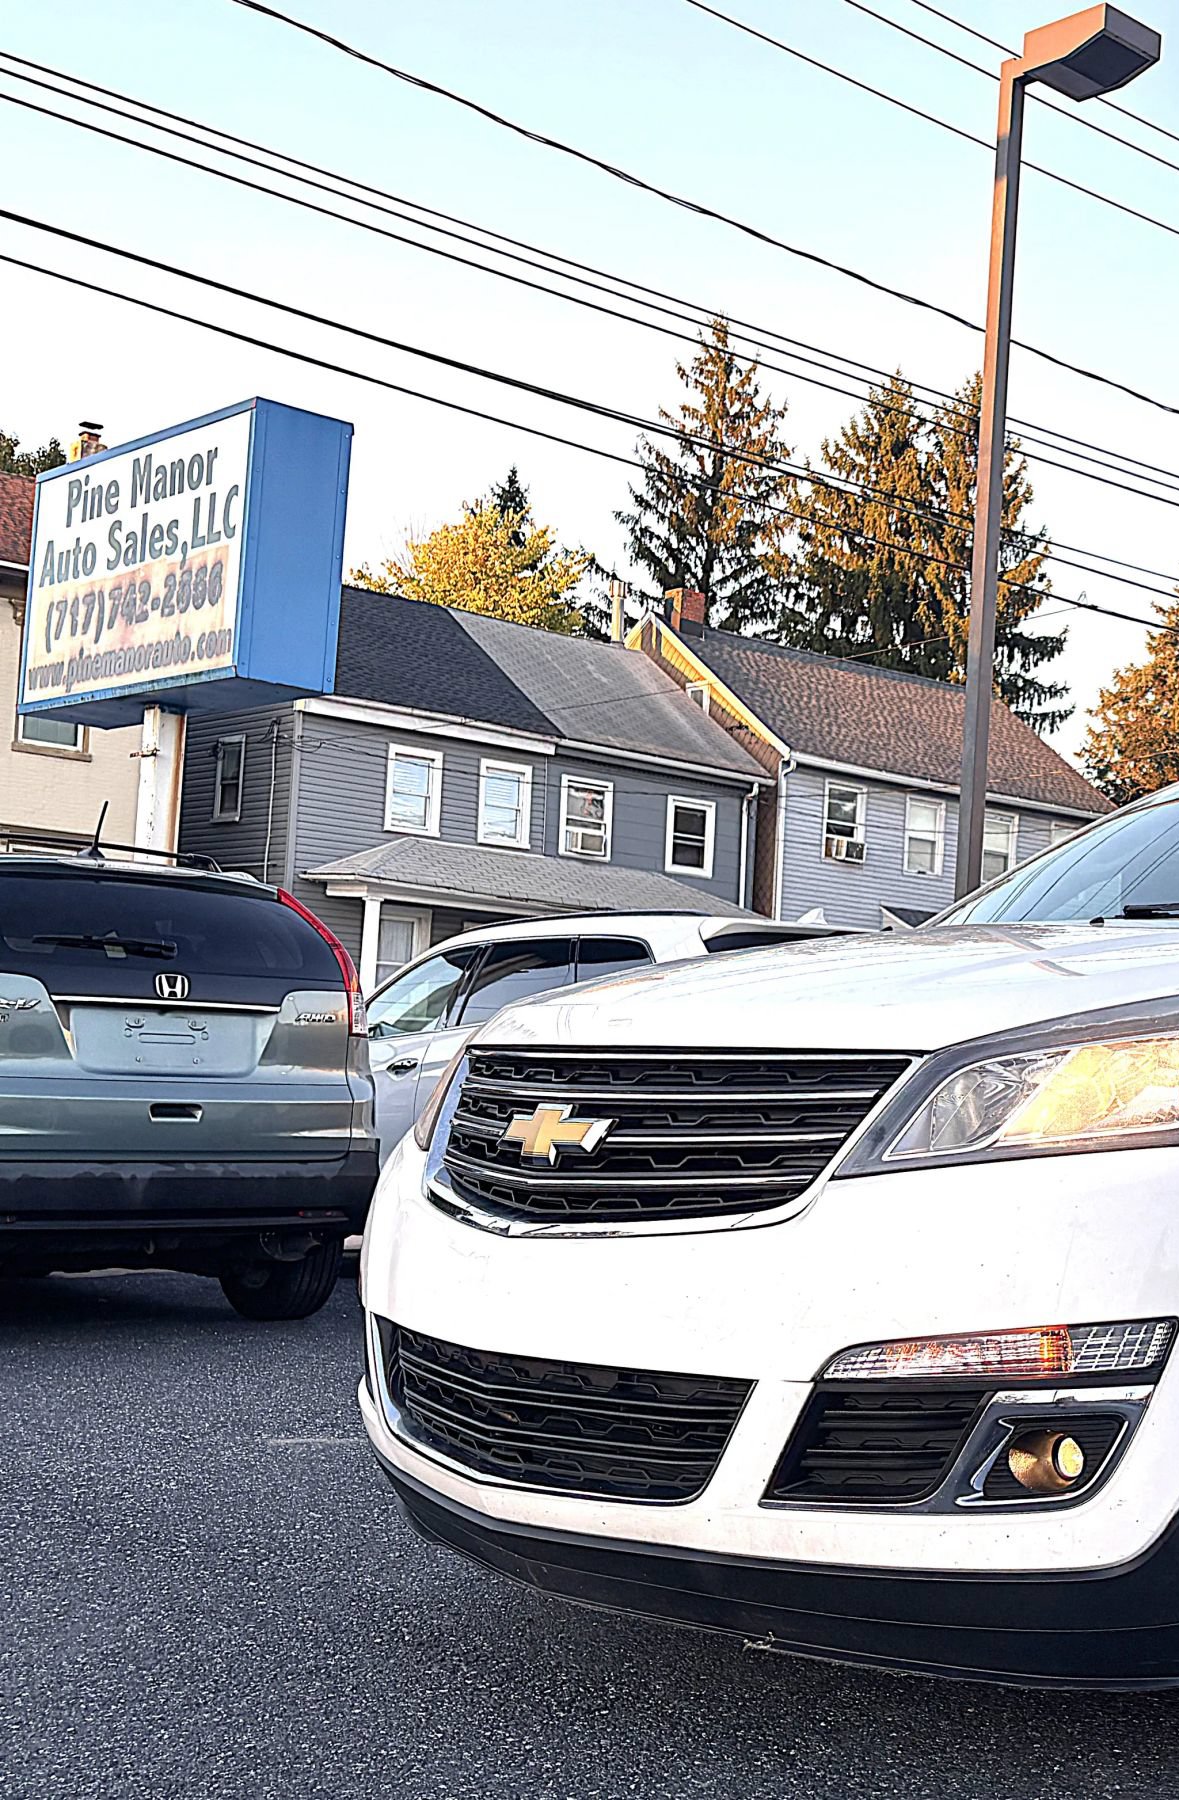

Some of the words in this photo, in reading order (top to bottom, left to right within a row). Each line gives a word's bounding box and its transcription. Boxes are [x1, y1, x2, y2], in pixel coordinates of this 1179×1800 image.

[66, 474, 120, 528] Pine
[130, 447, 218, 509] Manor
[39, 536, 98, 588] Auto
[28, 627, 232, 693] www.pinemanorauto.com
[295, 1012, 337, 1023] AWD
